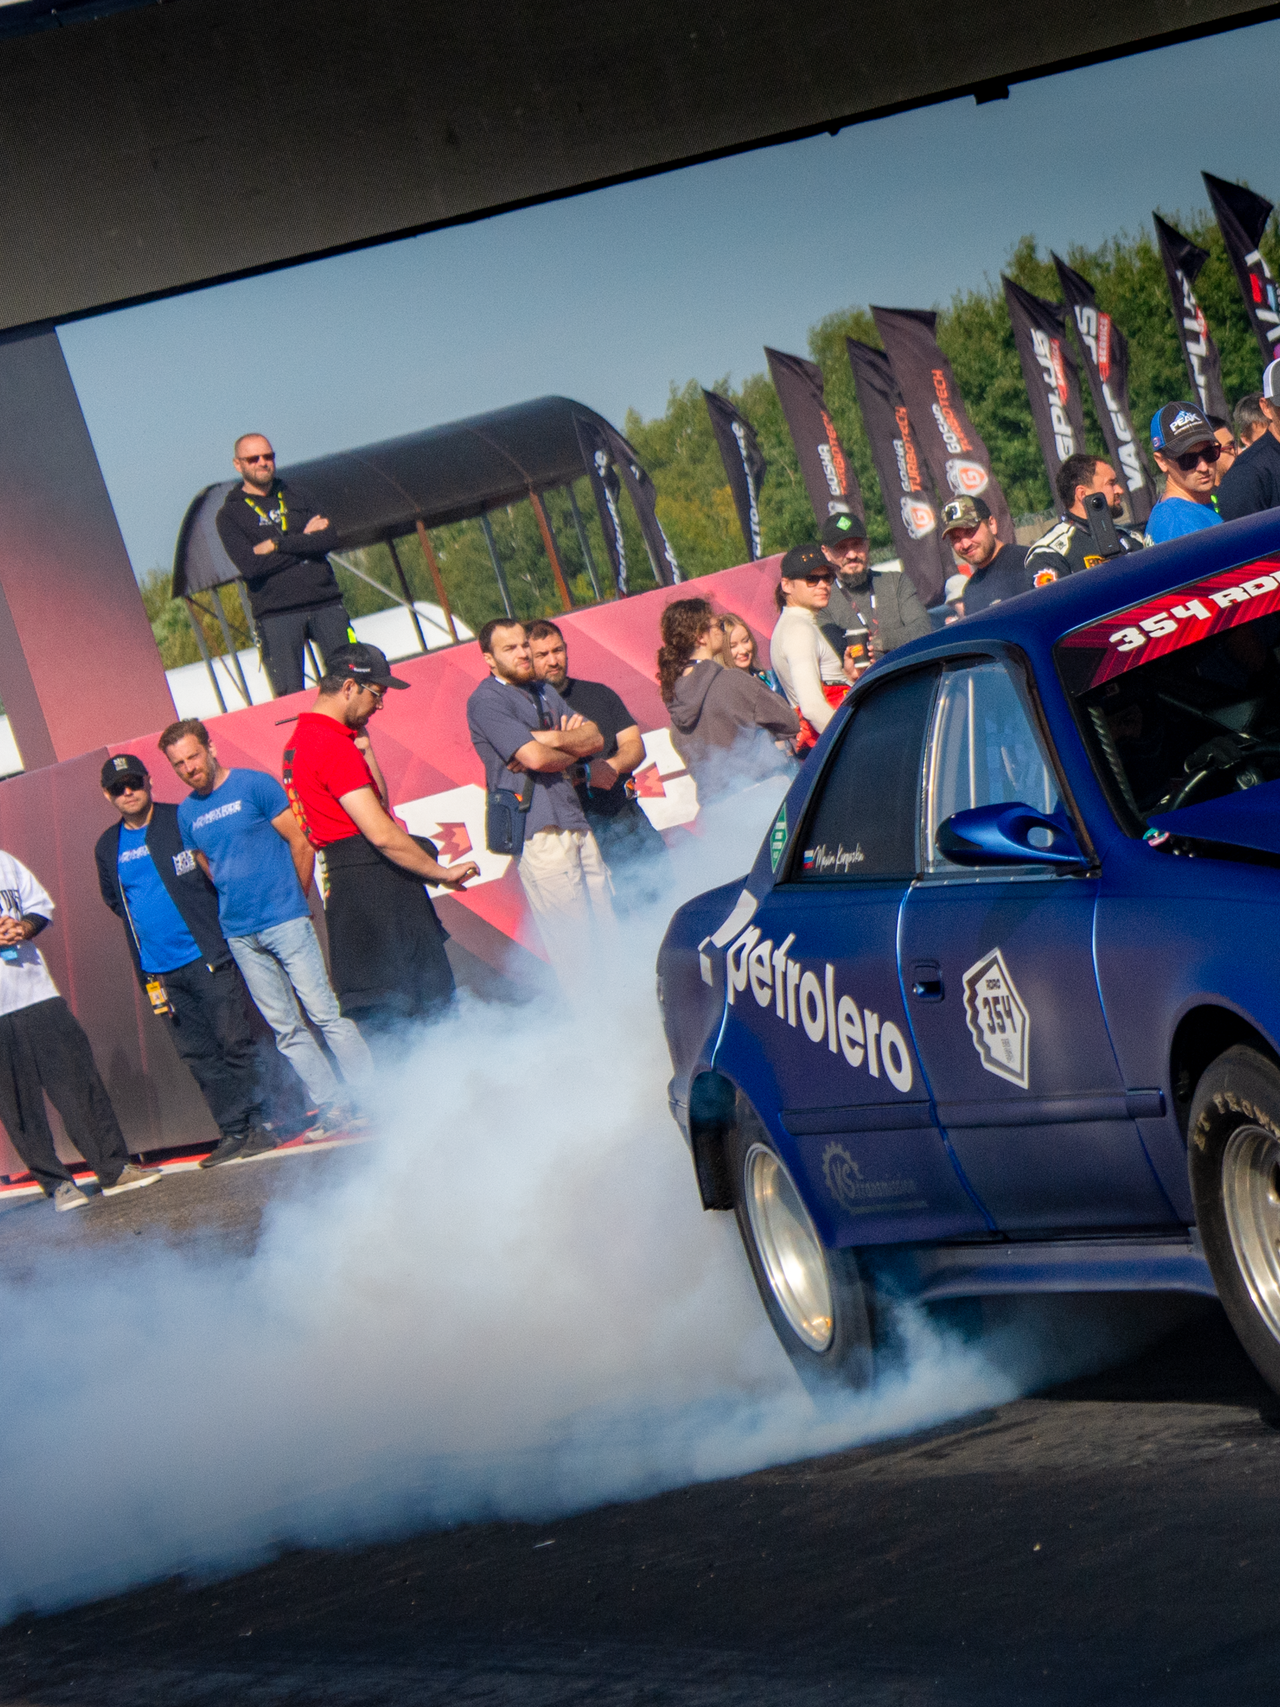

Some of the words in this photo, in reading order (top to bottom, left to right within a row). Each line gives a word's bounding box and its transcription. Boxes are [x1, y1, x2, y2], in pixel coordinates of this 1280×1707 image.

[895, 406, 922, 493] TURBOTECH
[1169, 413, 1201, 433] PEAK
[817, 443, 842, 496] GOSHA
[893, 439, 911, 493] GOSHA
[1108, 598, 1211, 652] 354
[726, 924, 913, 1093] petrolero
[982, 995, 1017, 1035] 354
